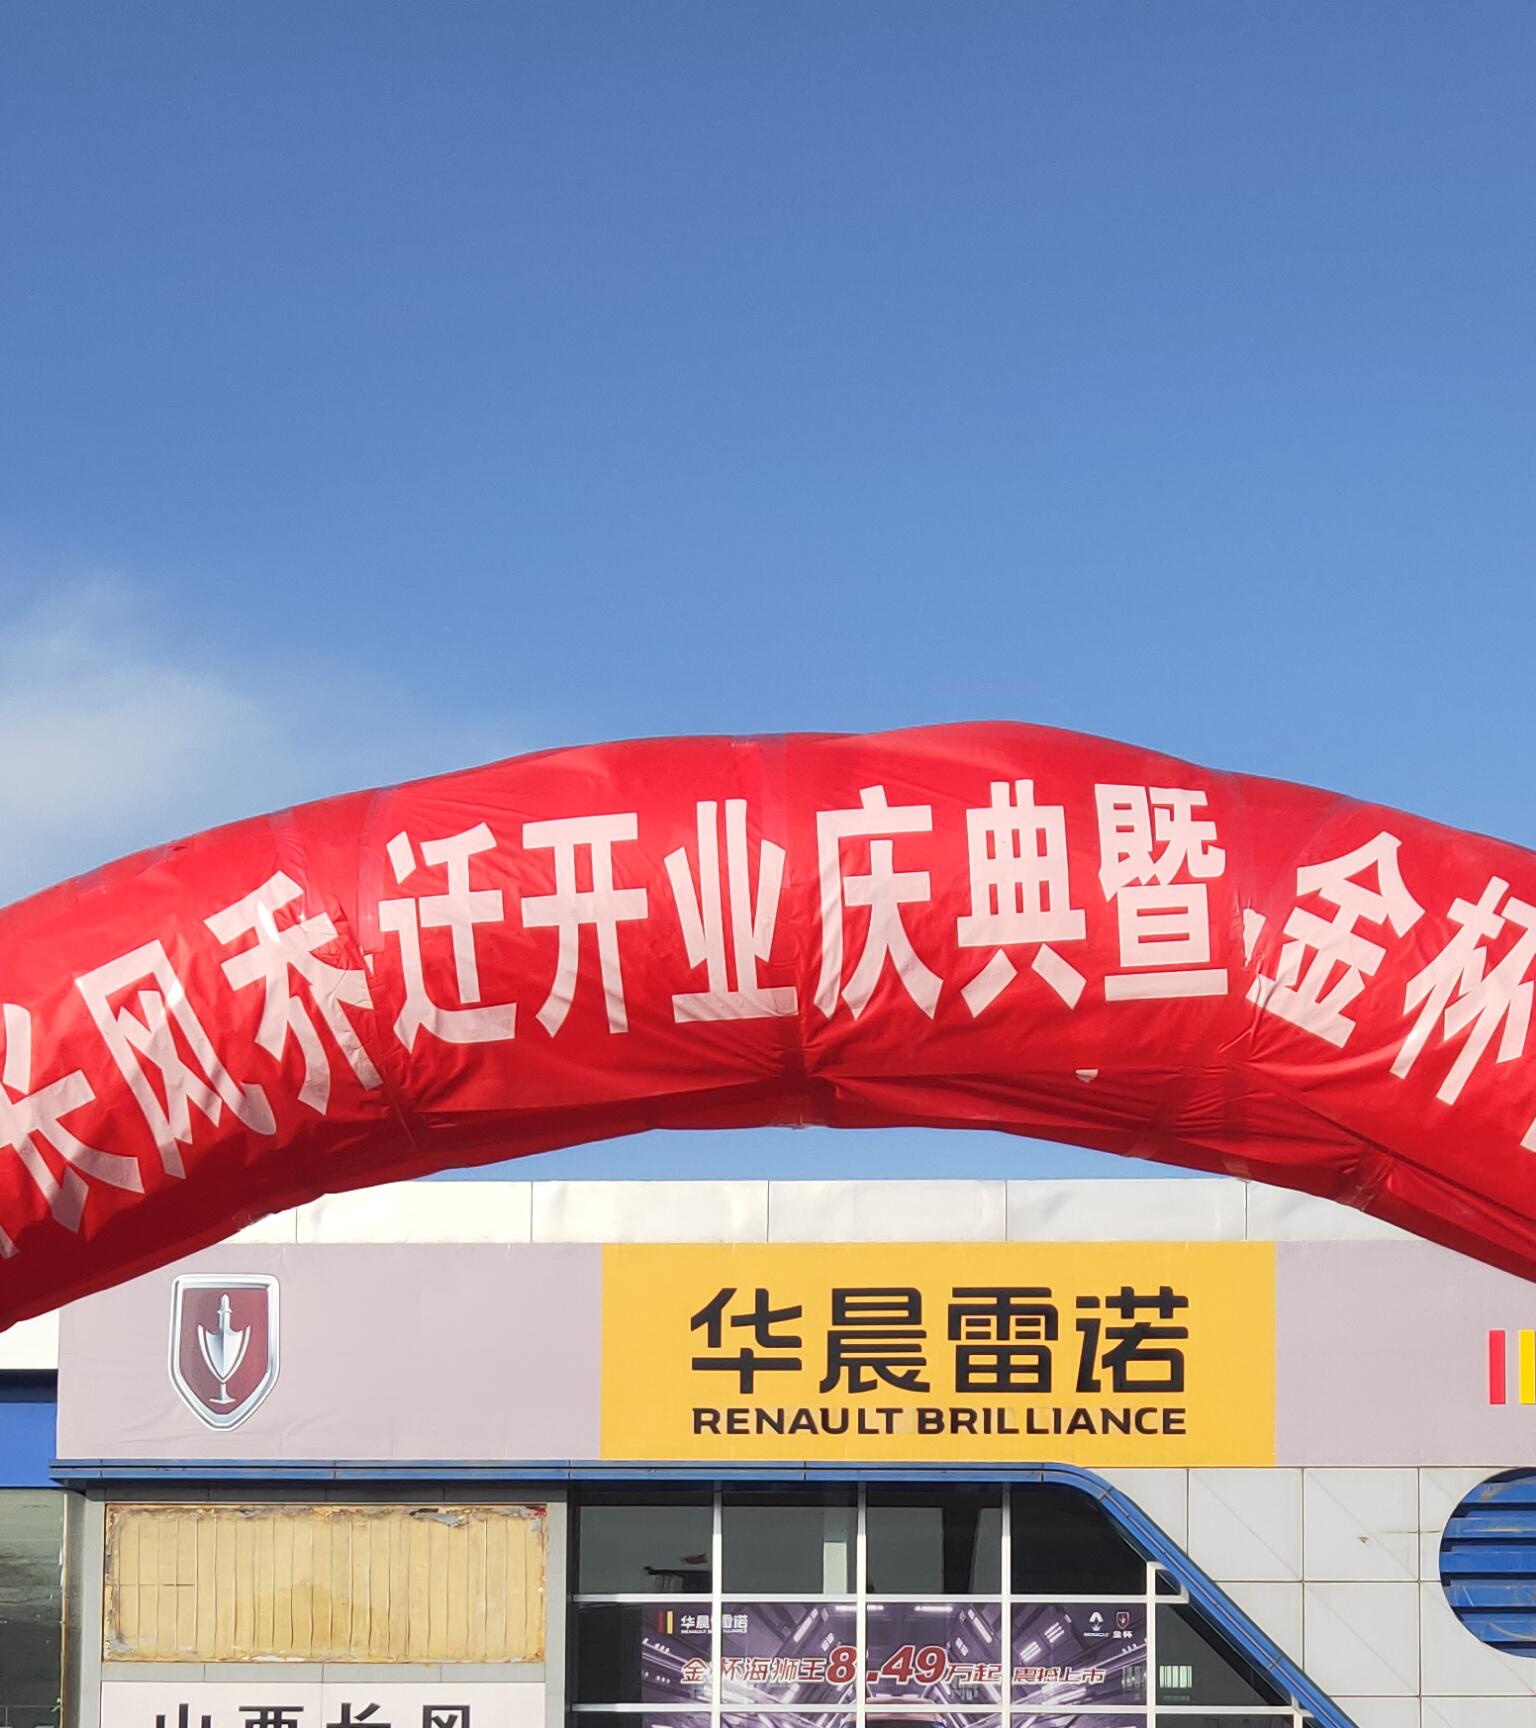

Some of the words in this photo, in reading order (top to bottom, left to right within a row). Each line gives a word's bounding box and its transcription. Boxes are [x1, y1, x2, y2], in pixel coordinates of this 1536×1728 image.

[690, 1286, 1190, 1395] 华晨雷诺
[693, 1408, 903, 1435] RENAULT
[917, 1408, 1186, 1435] BRILLIANCE
